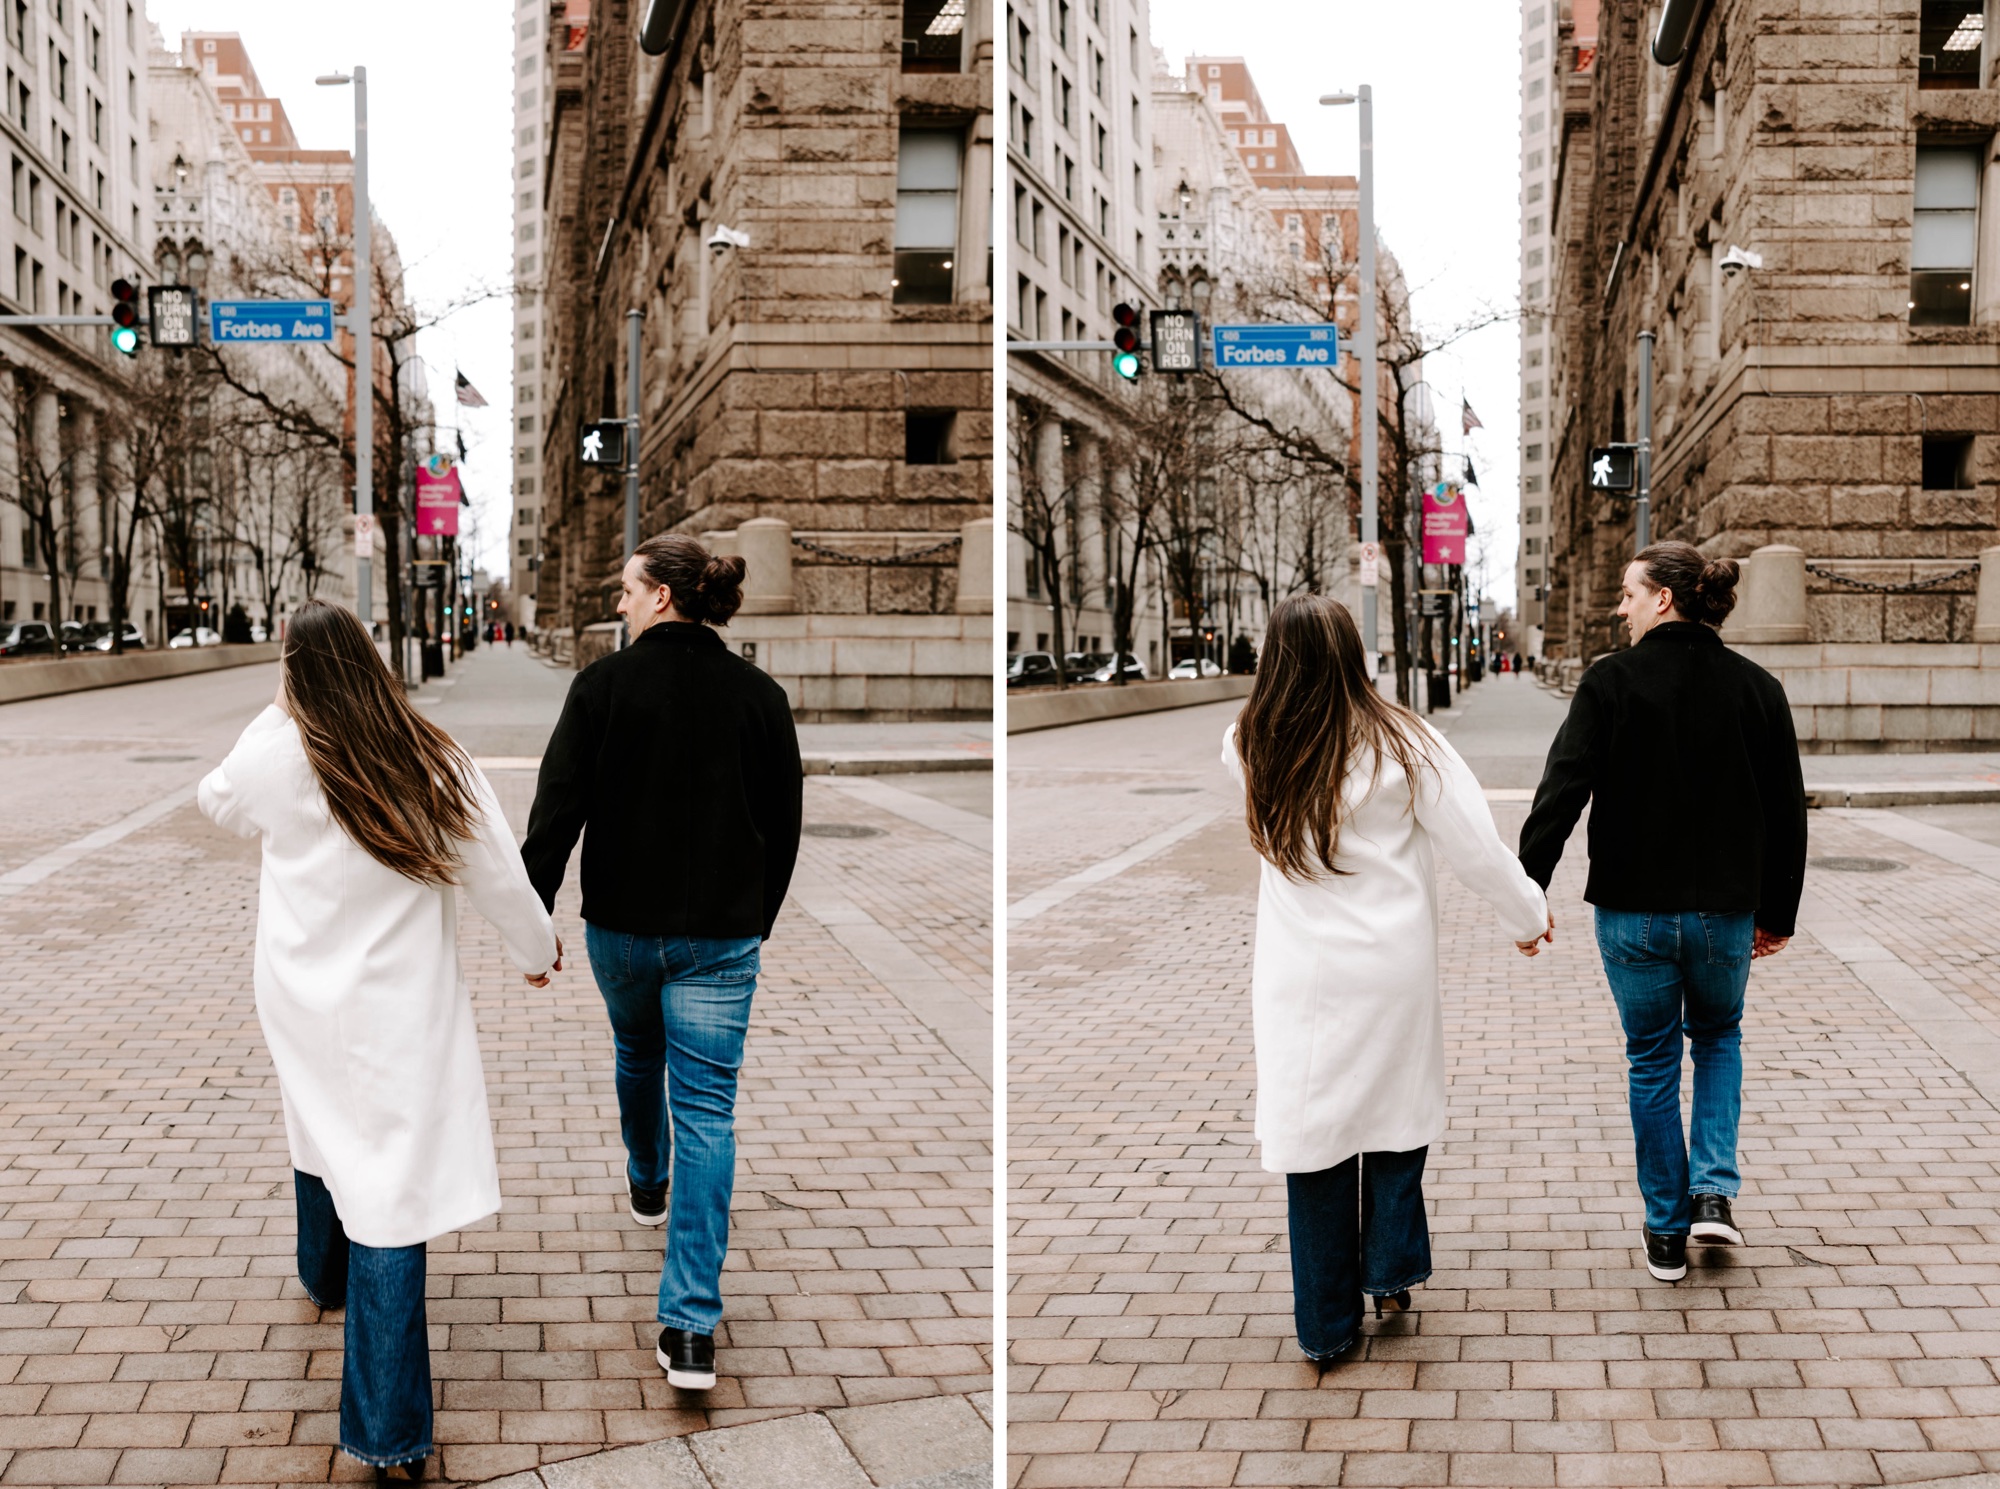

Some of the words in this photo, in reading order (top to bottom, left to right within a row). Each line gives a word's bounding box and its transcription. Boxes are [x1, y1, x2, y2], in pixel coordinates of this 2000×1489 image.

[162, 290, 182, 303] NO
[154, 303, 192, 317] TURN
[163, 317, 183, 329] ON
[1164, 315, 1184, 328] NO
[220, 320, 283, 338] Forbes
[291, 320, 324, 338] Ave
[1156, 328, 1194, 341] TURN
[159, 329, 189, 343] RED
[1165, 341, 1186, 354] ON
[1223, 345, 1286, 363] Forbes
[1295, 345, 1329, 362] Ave
[1161, 354, 1191, 367] RED
